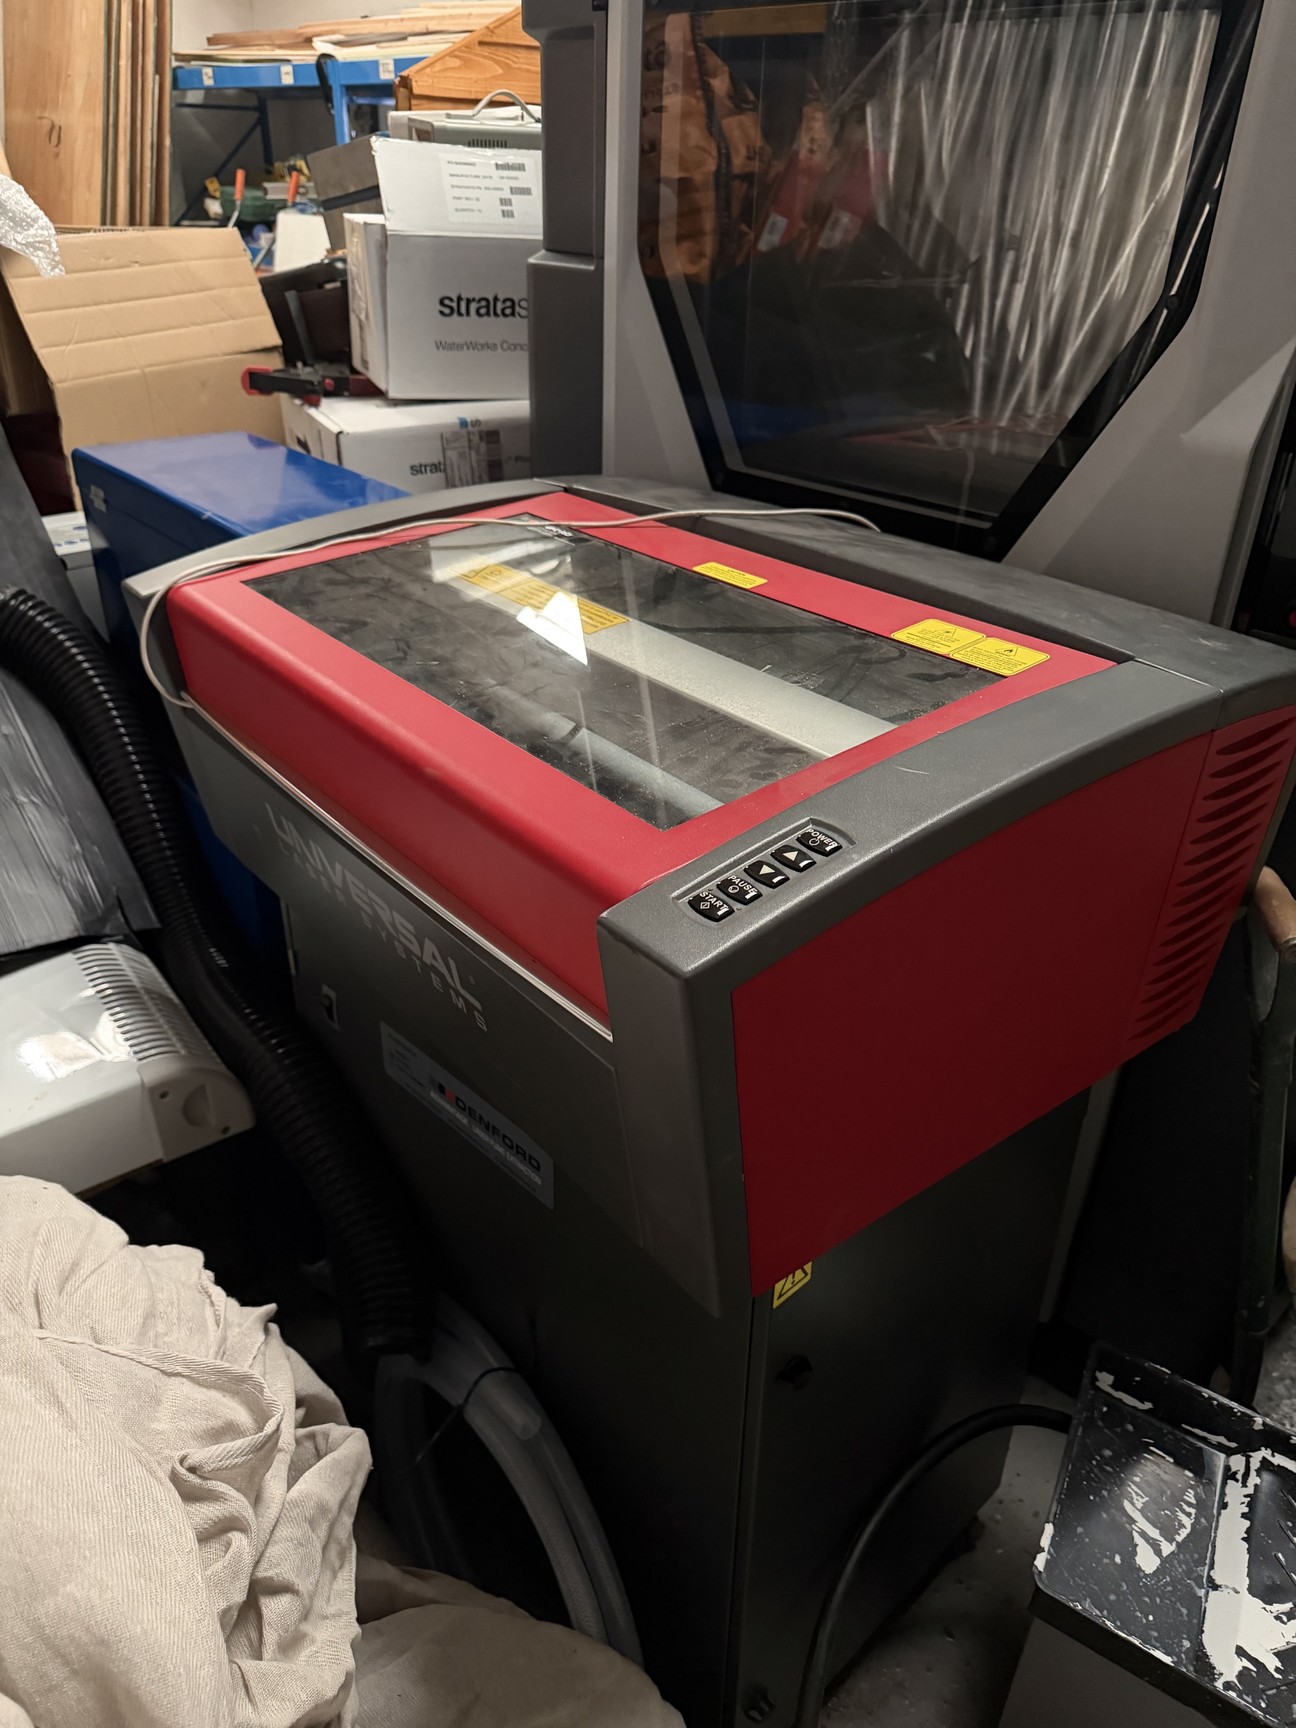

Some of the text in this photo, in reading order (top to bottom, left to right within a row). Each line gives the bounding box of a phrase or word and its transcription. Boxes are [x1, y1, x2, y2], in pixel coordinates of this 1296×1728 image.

[438, 293, 528, 319] stratas
[434, 340, 498, 352] WaterWorks
[409, 461, 447, 476] strat
[805, 827, 839, 847] POWER
[727, 874, 758, 895] PAUSE
[265, 802, 483, 1012] UNIVERSAL
[699, 890, 730, 912] START
[359, 908, 488, 1032] SYSTEMS
[455, 1095, 541, 1172] DENFORD
